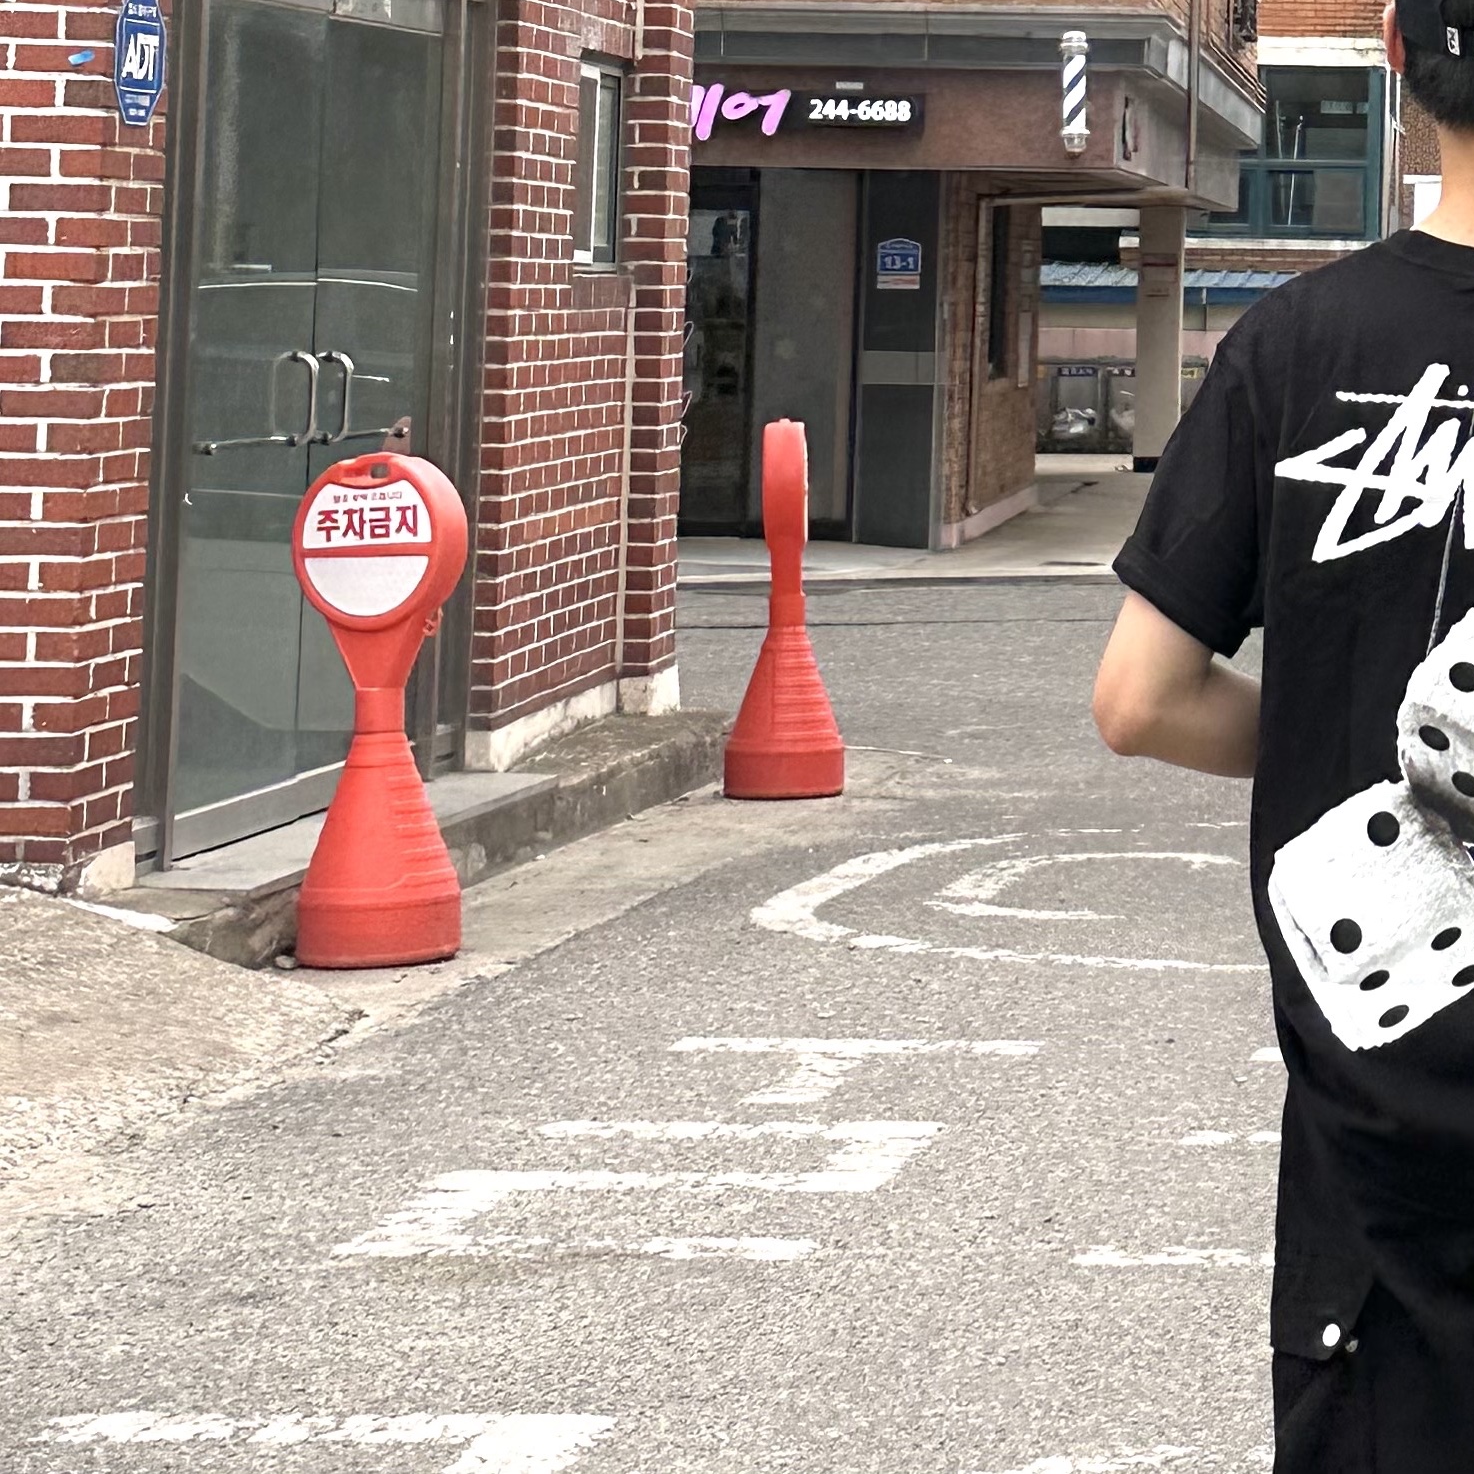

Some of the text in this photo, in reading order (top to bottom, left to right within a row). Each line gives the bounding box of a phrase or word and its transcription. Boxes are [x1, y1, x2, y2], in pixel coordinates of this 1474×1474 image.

[121, 33, 160, 81] ADT
[809, 99, 911, 122] 244-6688
[316, 504, 419, 543] 주차금지
